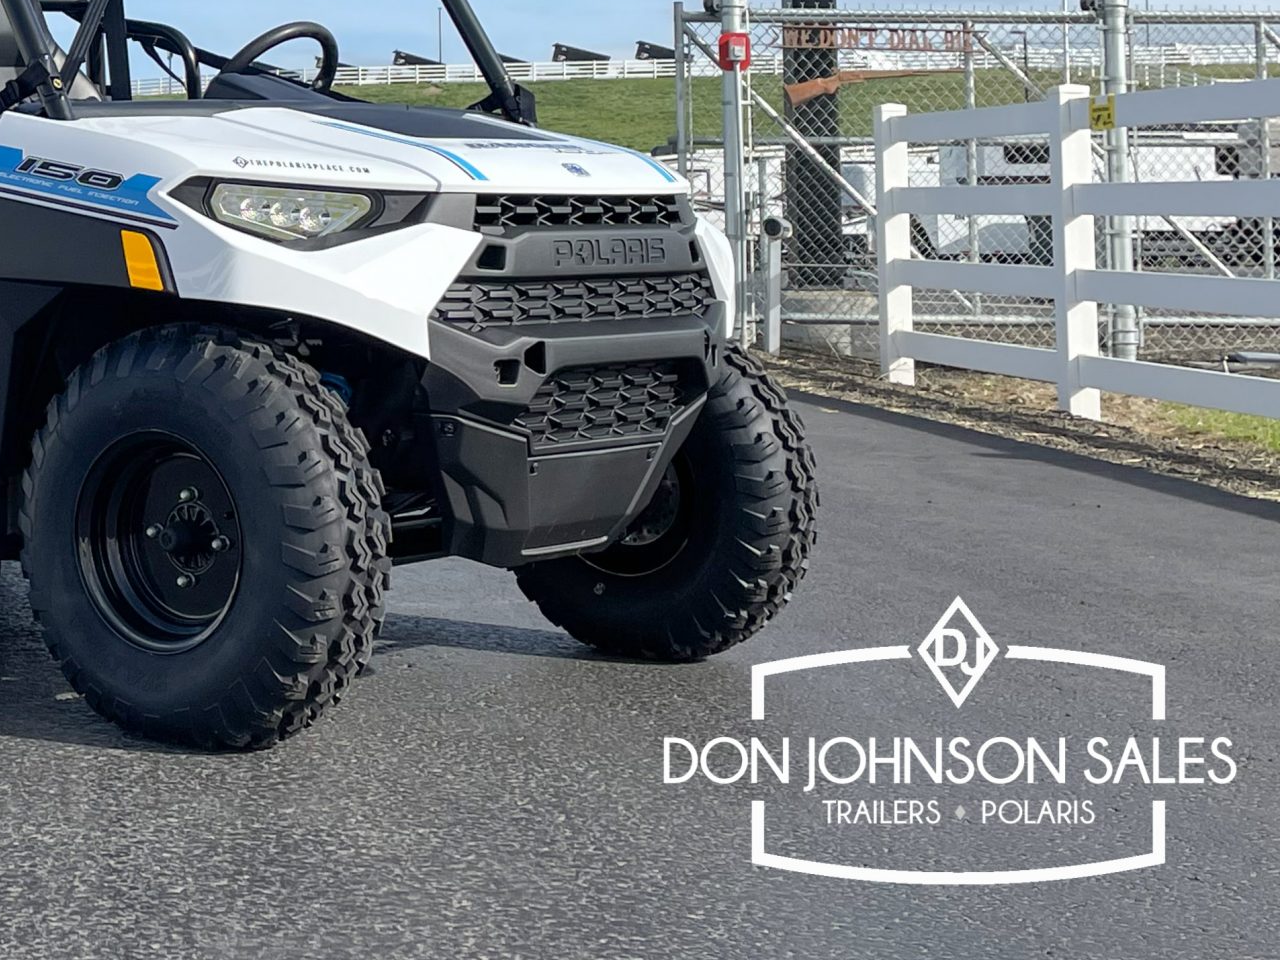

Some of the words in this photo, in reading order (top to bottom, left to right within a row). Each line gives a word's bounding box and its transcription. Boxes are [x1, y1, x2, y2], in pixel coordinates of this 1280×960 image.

[14, 155, 126, 191] 150
[58, 185, 83, 195] FUEL
[87, 191, 140, 206] INJECTION
[552, 237, 666, 267] POLARIS
